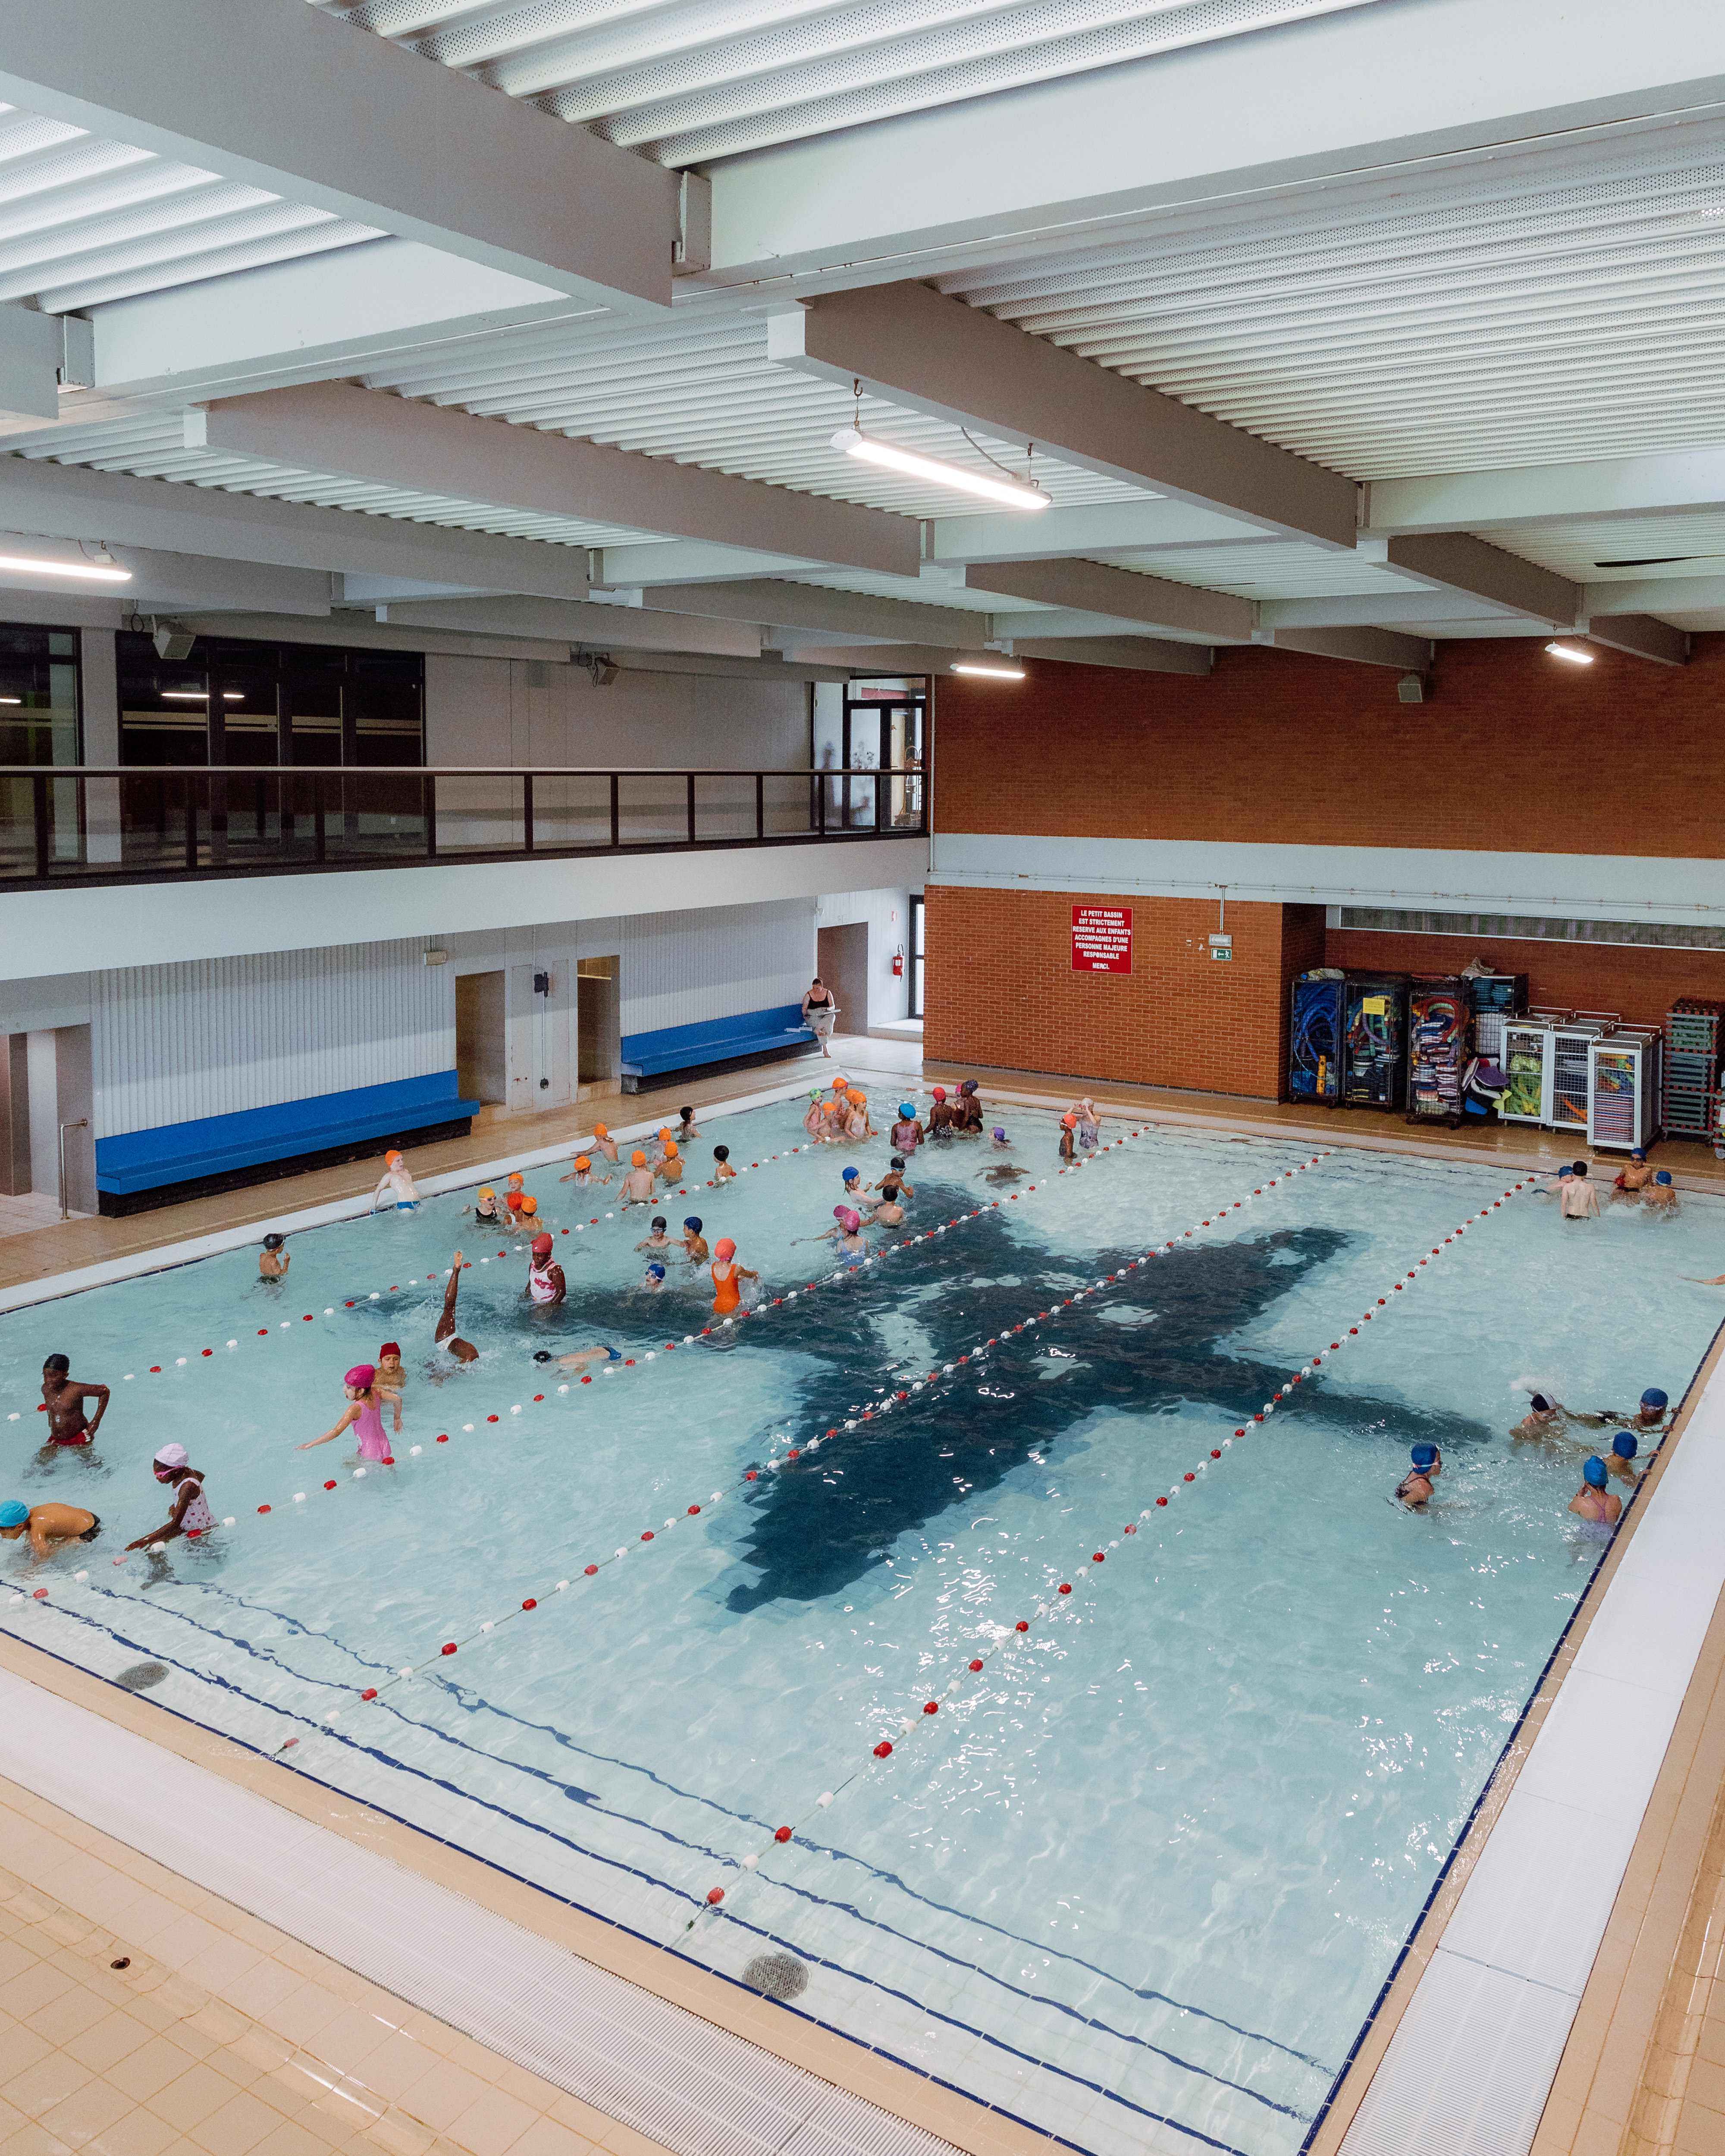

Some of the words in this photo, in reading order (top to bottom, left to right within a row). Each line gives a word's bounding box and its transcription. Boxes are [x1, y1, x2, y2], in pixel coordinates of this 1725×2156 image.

[1089, 918, 1125, 927] STRICTEMENT
[1075, 934, 1112, 942] ACCOMPAGNES
[1083, 951, 1119, 959] RESPONSABLE
